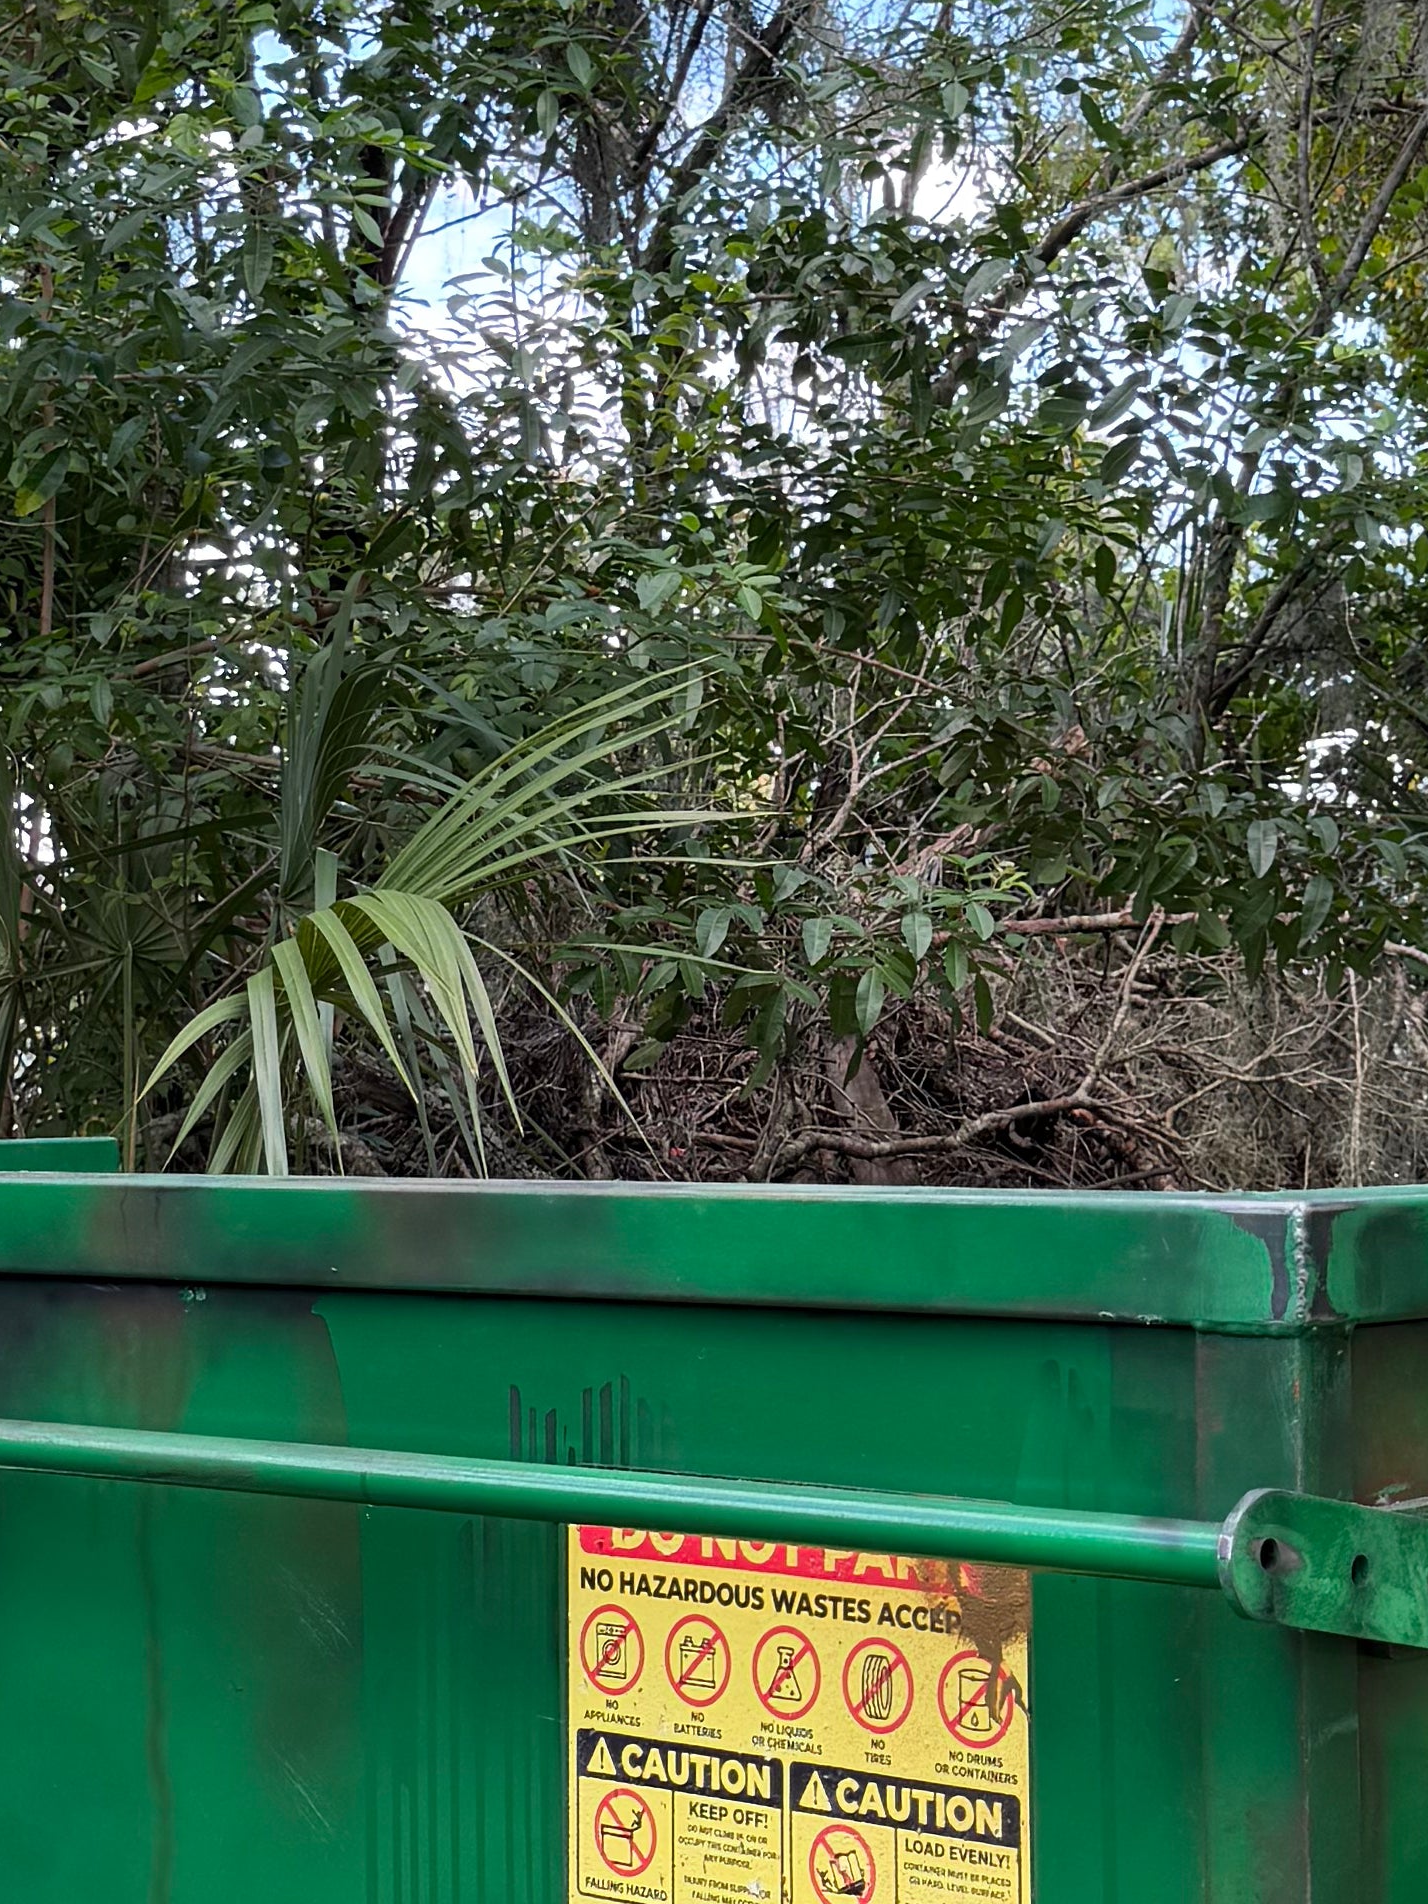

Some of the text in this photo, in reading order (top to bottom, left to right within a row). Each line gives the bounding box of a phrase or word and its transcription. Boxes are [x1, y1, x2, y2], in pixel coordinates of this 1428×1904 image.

[580, 1566, 962, 1634] NO HAZARDOUS WASTES ACCEP
[605, 1699, 619, 1711] NO
[584, 1710, 642, 1728] APPLIANCES
[690, 1711, 705, 1723] NO
[673, 1723, 723, 1739] BATTERIES
[760, 1721, 814, 1739] NO LIQUIDS
[751, 1735, 823, 1756] OR CHEMICALS
[871, 1739, 886, 1751] NO
[865, 1752, 893, 1766] TIRES
[948, 1750, 1004, 1768] NO DRUMS
[620, 1743, 772, 1800] CAUTION
[935, 1763, 1019, 1786] OR CONTAINERS
[688, 1801, 768, 1829] KEEP OFF!
[835, 1777, 1003, 1839] CAUTION
[904, 1838, 1011, 1870] LOAD EVENLY!
[585, 1876, 667, 1902] FALLING HAZARD
